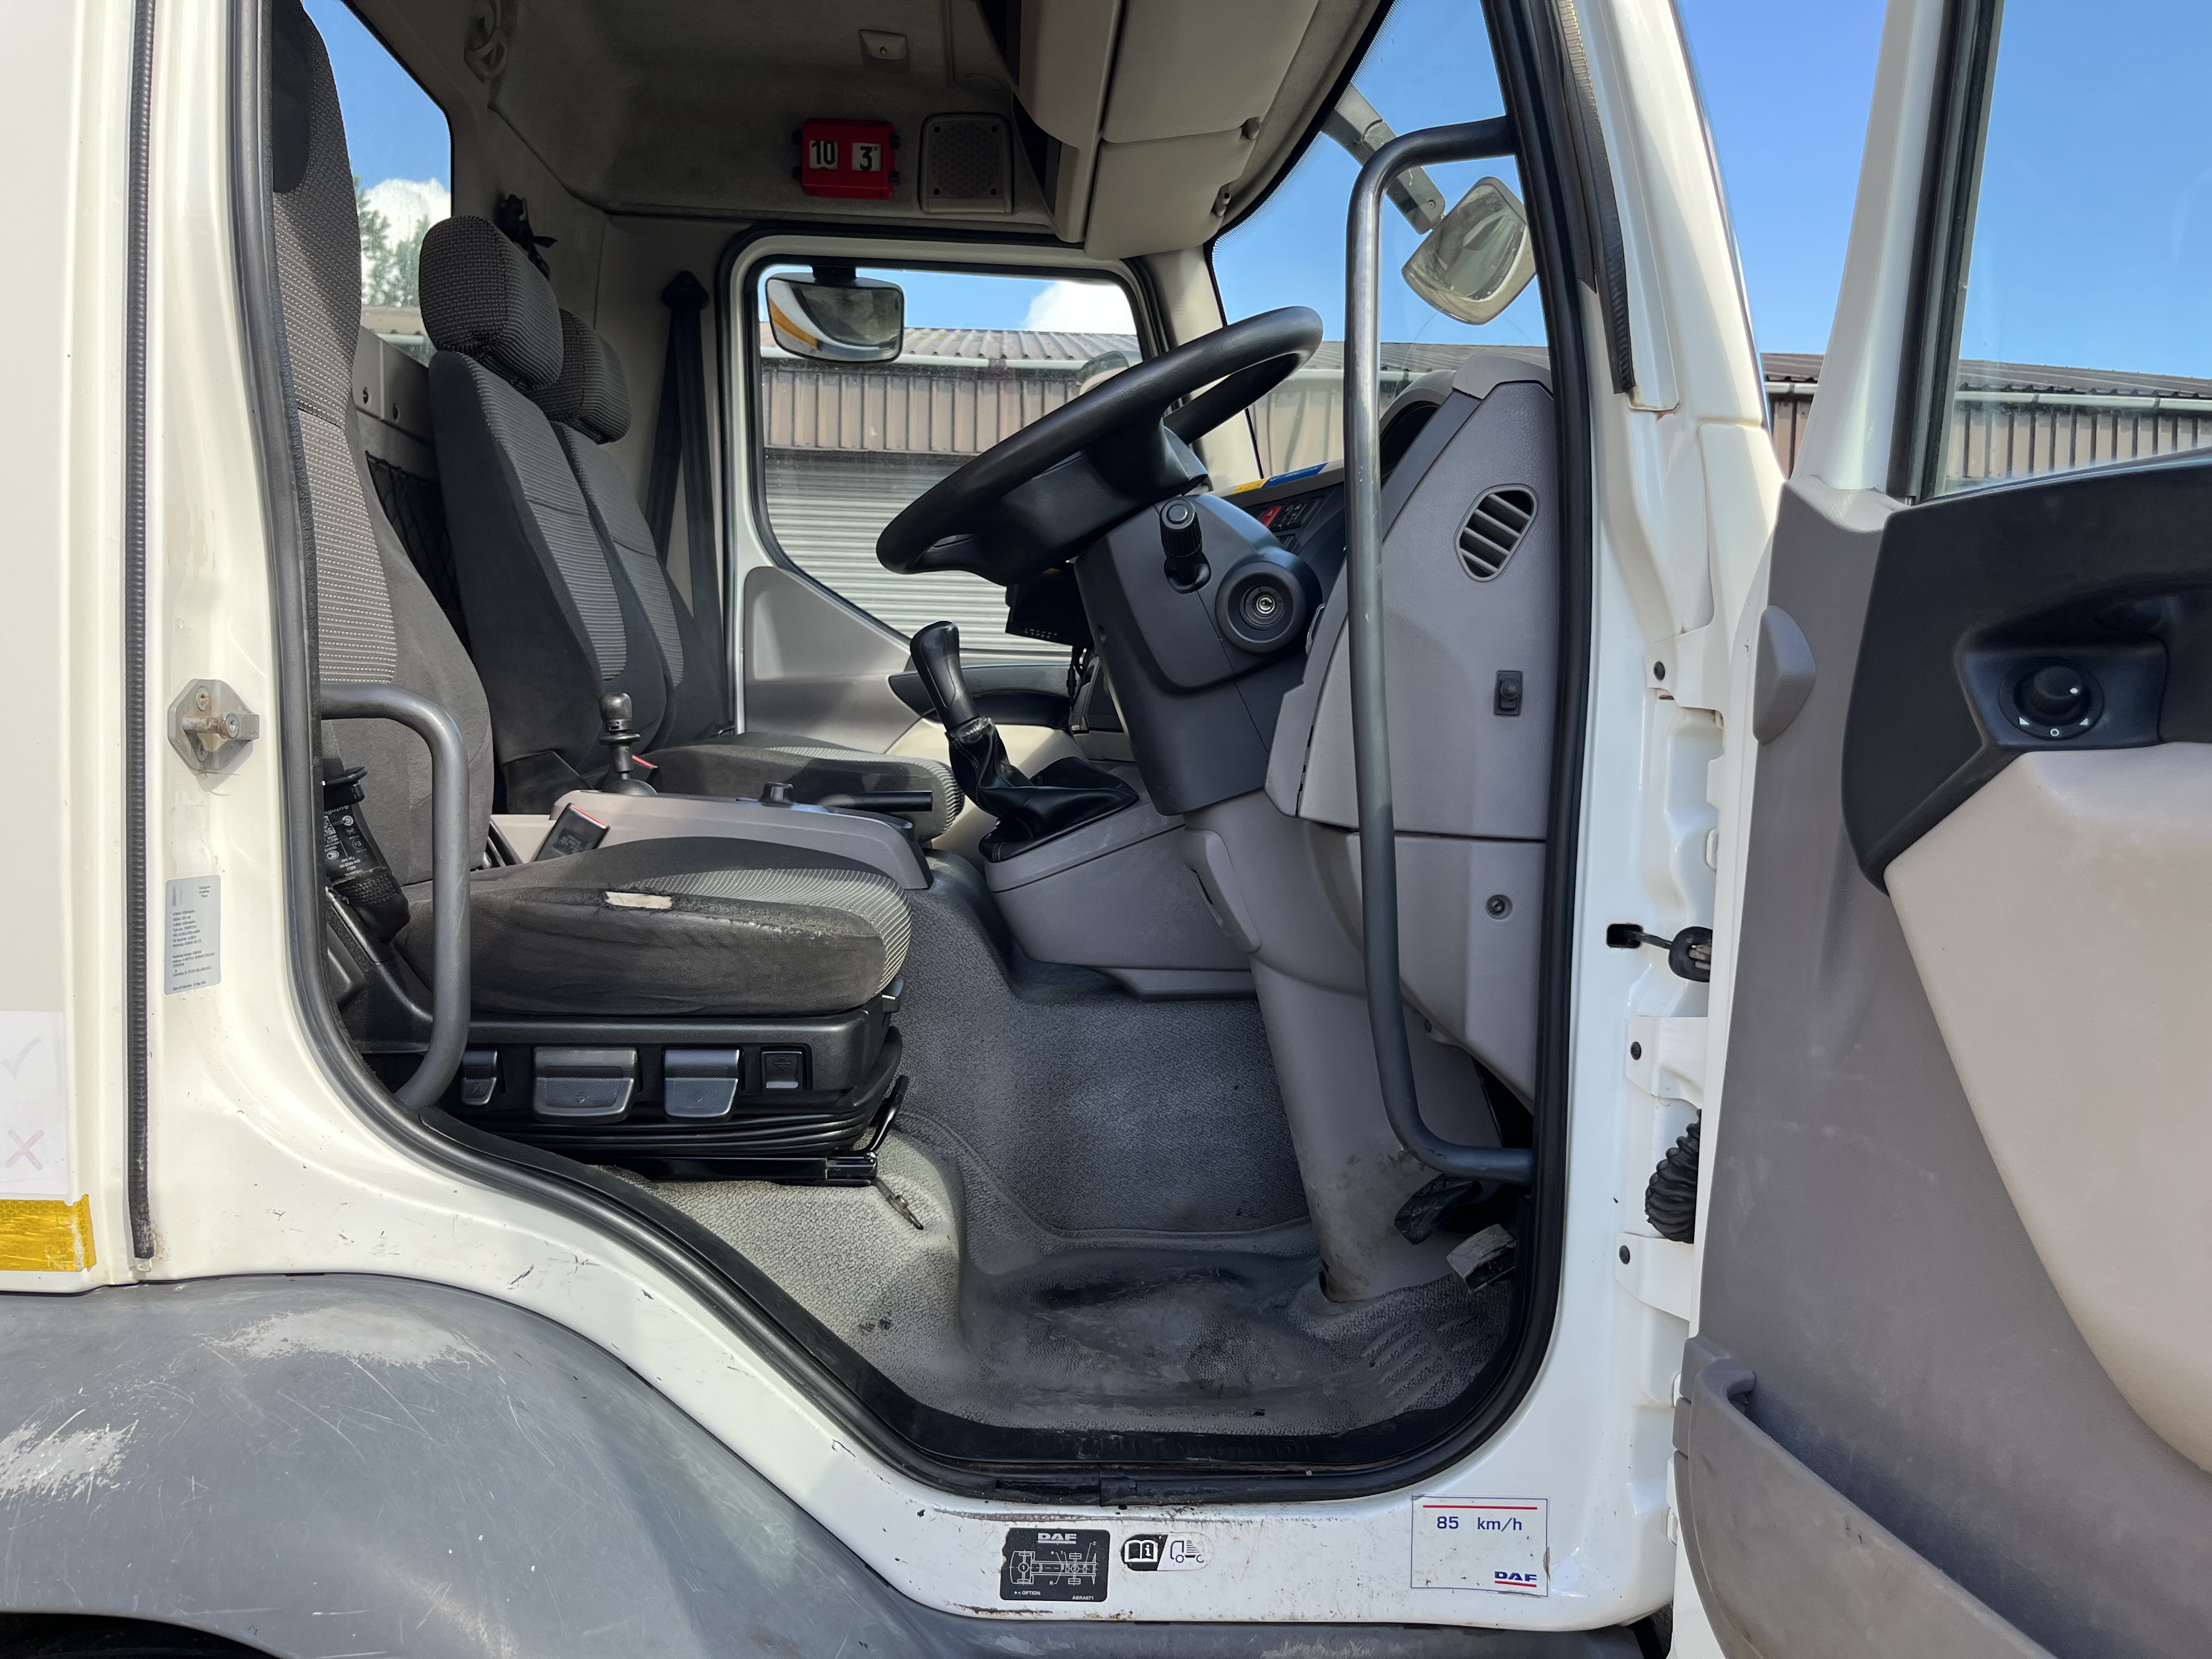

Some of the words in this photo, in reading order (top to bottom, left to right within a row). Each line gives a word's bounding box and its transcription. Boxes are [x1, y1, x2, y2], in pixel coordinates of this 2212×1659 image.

[1437, 1516, 1459, 1529] 85
[1477, 1517, 1522, 1532] km/h
[1494, 1571, 1537, 1582] DAF
